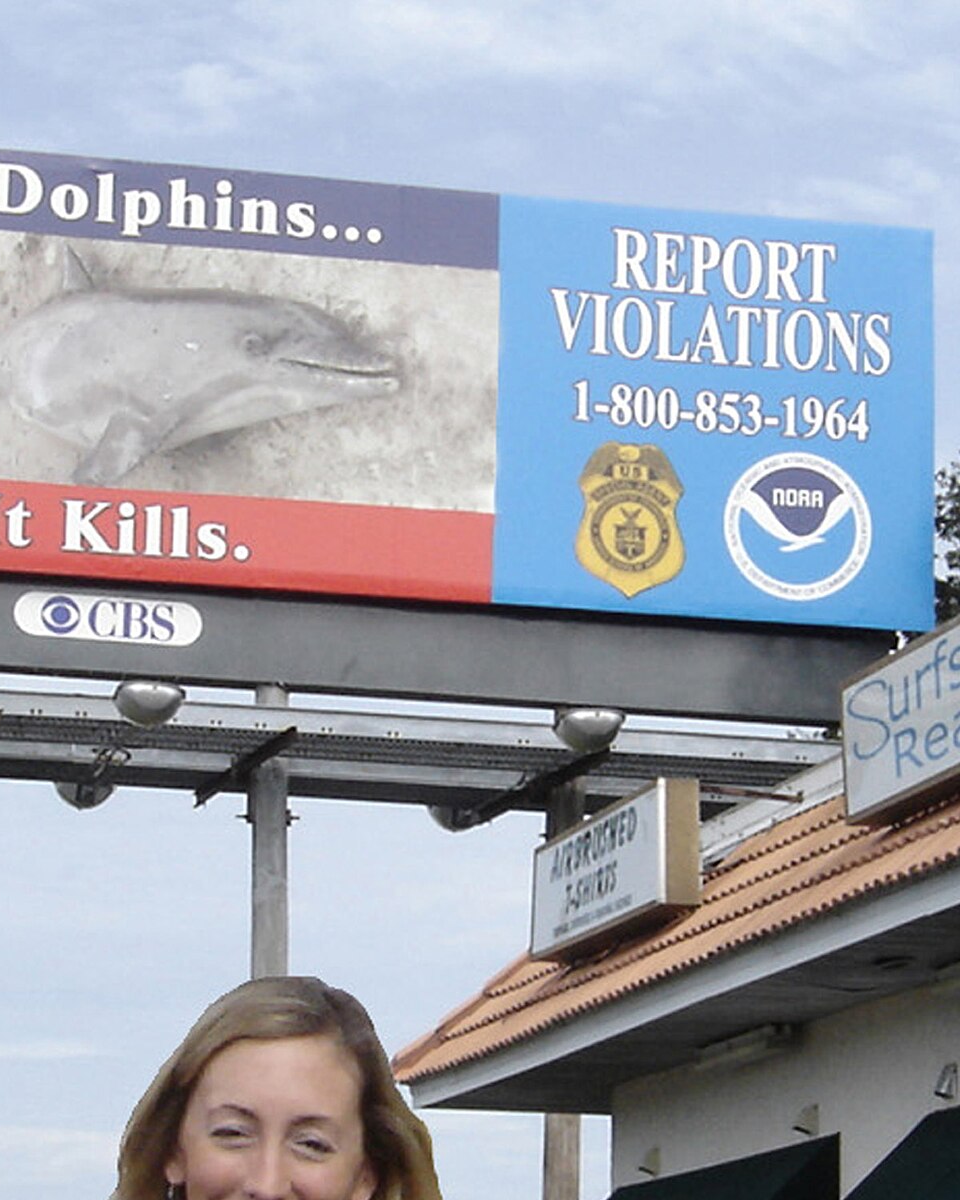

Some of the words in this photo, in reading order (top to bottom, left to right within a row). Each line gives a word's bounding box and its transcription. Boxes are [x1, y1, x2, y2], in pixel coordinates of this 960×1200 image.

[611, 227, 836, 303] REPORT
[550, 288, 893, 376] VIOLATIONS
[572, 379, 870, 442] 1-800-853-1964
[772, 488, 824, 509] NOAA
[61, 499, 251, 562] Kills.
[89, 599, 175, 642] CBS
